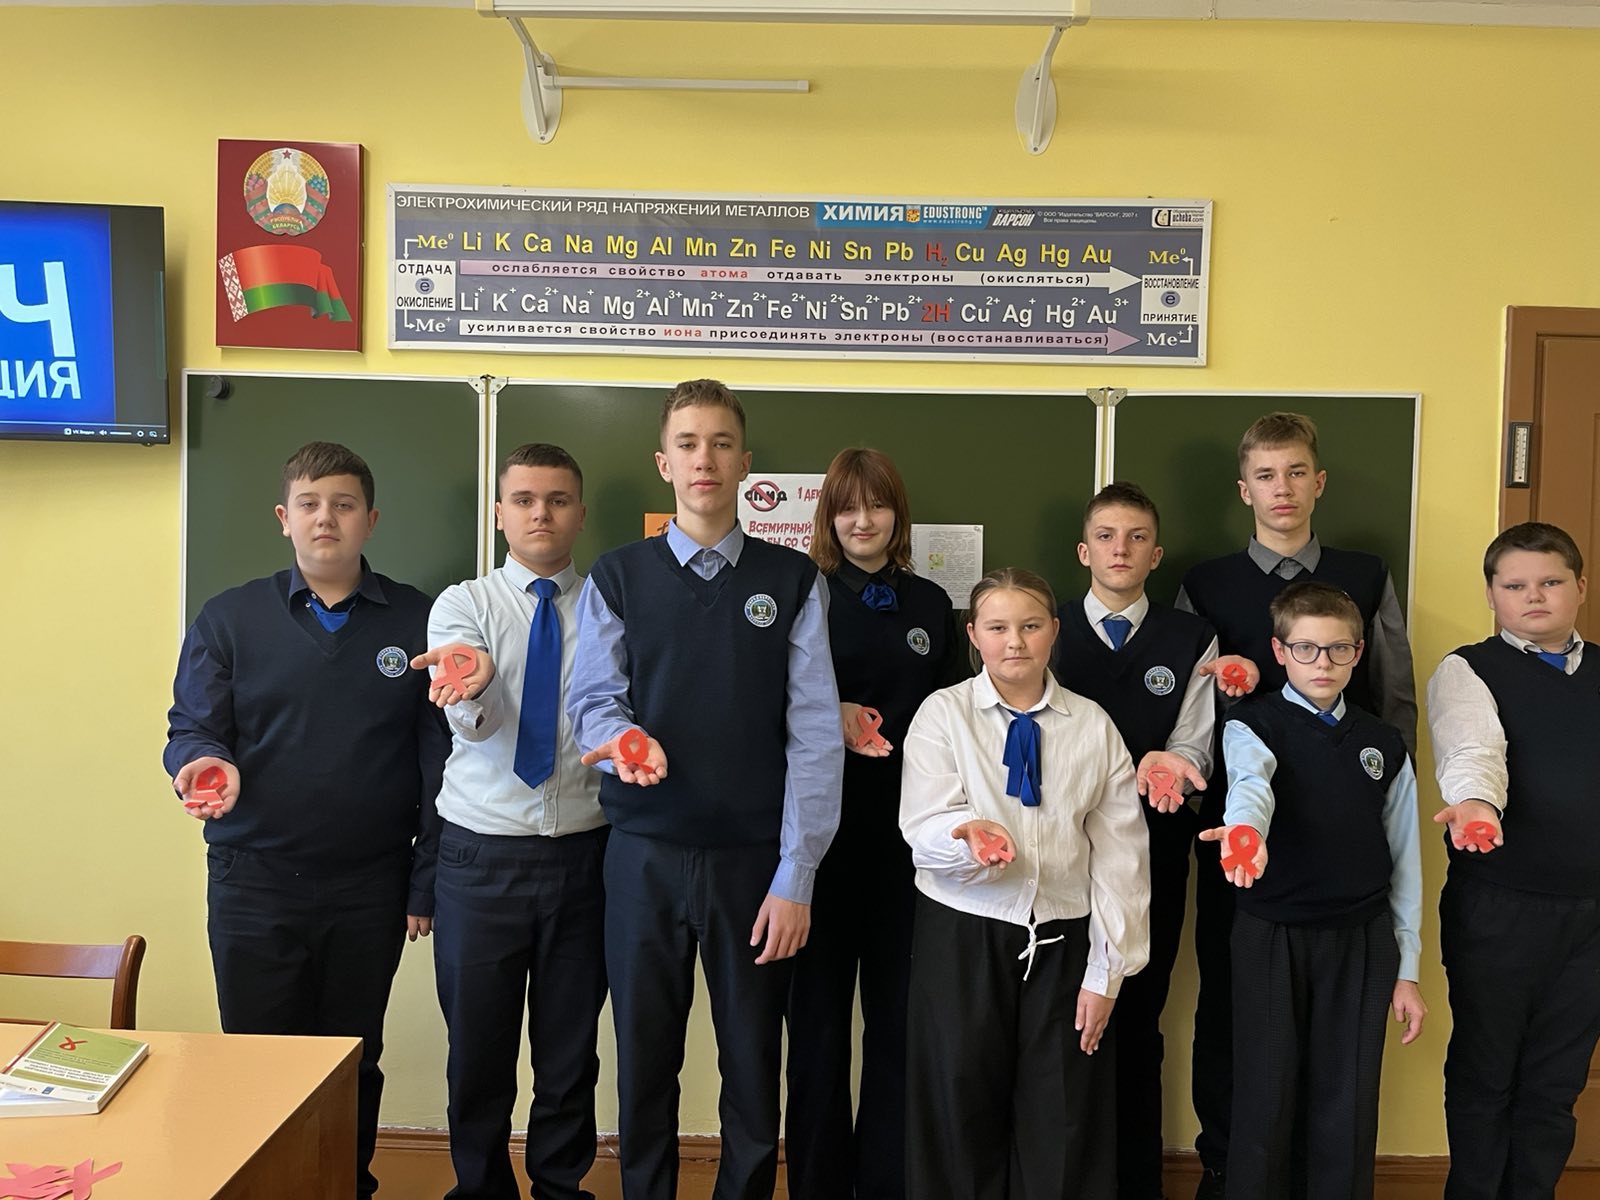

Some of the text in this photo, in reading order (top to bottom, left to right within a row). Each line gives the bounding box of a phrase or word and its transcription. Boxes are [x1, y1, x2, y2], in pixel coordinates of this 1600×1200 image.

[396, 195, 810, 218] ЭЛЕКТРОХИМИЧЕСКИЙ РЯД НАПРЯЖЕНИЙ МЕТАЛЛОВ
[823, 204, 904, 221] ХИМИЯ
[462, 231, 482, 251] Li
[495, 232, 511, 252] K
[523, 233, 552, 253] Ca
[565, 234, 593, 254] Na
[606, 235, 638, 259] Mg
[650, 236, 672, 256] Al
[685, 237, 717, 257] Mn
[729, 238, 756, 258] Zn
[770, 239, 796, 259] Fe
[809, 241, 830, 260] Ni
[844, 241, 872, 260] Sn
[885, 242, 913, 261] Pb
[955, 242, 984, 262] Cu
[996, 243, 1027, 268] Ag
[1039, 244, 1070, 268] Hg
[1081, 244, 1112, 264] Au
[398, 263, 453, 275] ОТДАЧА
[492, 263, 1090, 286] ослабляется свойство атома отдавать электроны (окисляться)
[1144, 278, 1199, 289] ВОССТАНОВЛЕНИЕ
[396, 296, 454, 308] ОКИСЛЕНИЕ
[1143, 312, 1197, 322] ПРИНЯТИЕ
[467, 322, 1109, 346] усиливается свойство иона присоединять электроны (восстанавливаться)
[798, 487, 803, 500] 1
